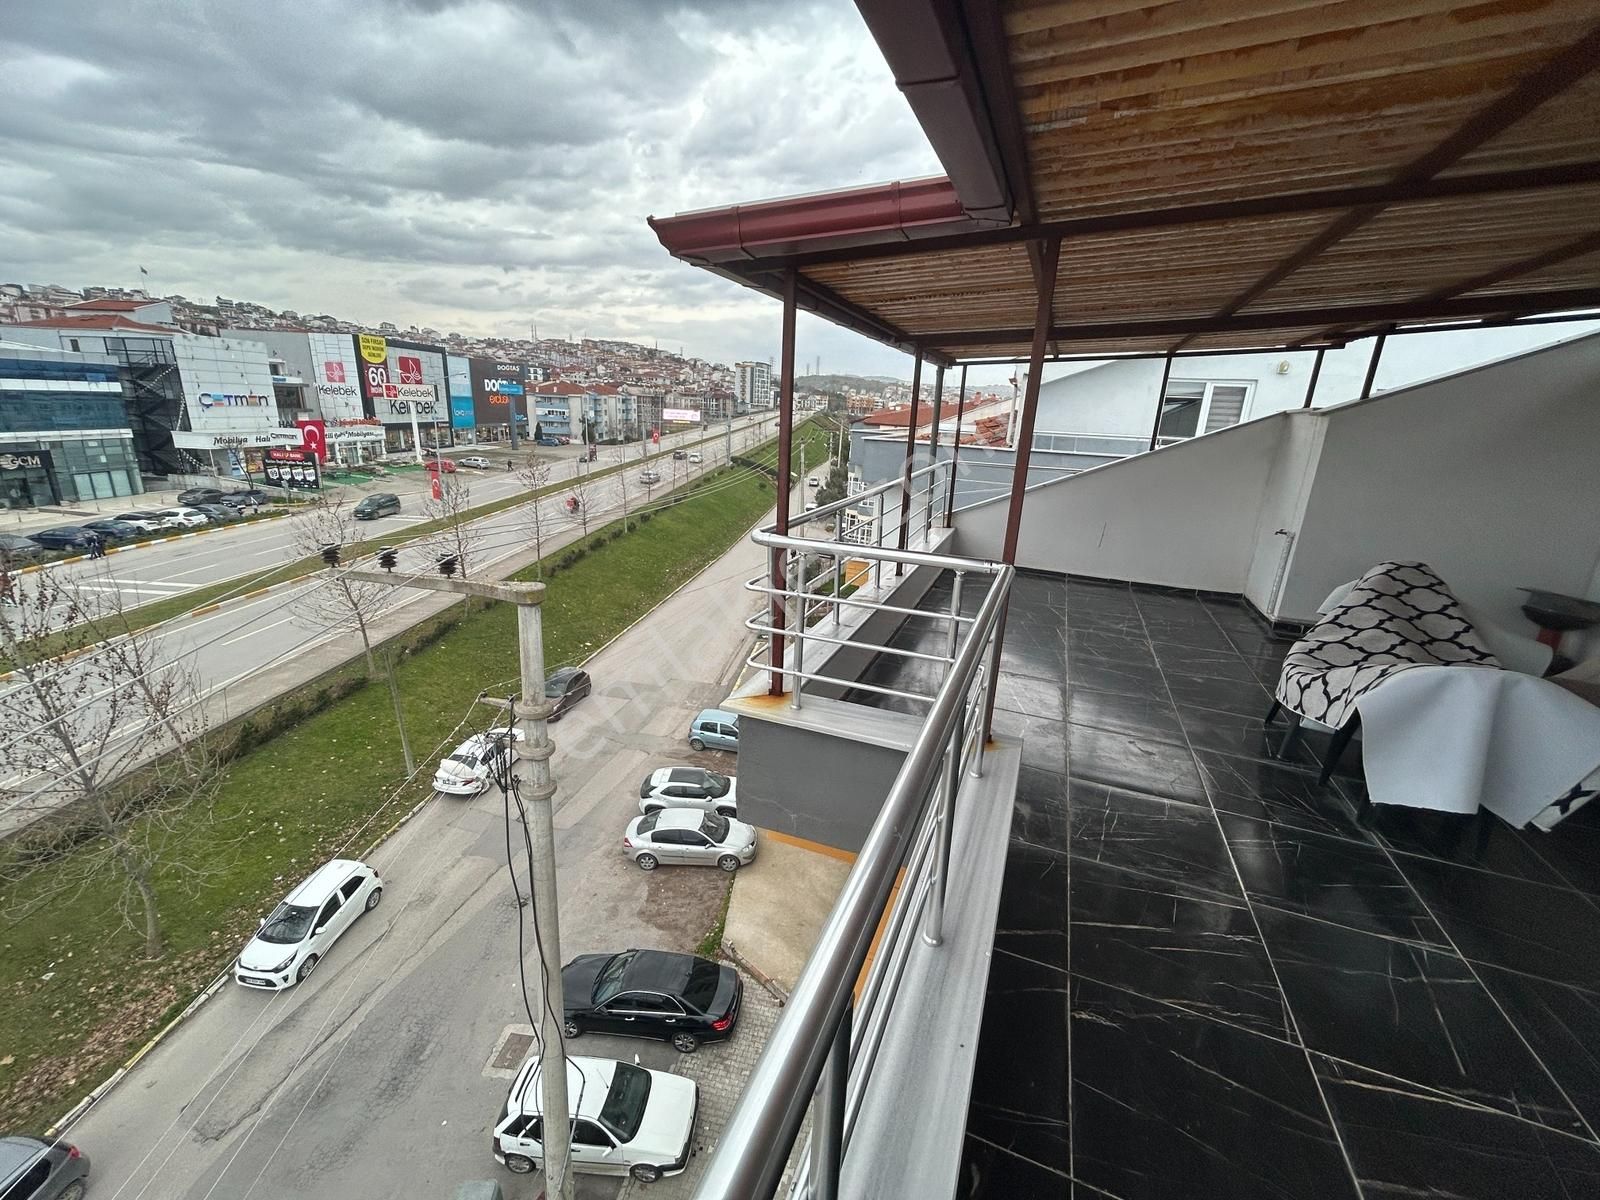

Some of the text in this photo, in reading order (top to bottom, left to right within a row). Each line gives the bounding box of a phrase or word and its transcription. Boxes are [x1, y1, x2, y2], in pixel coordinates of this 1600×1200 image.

[318, 384, 357, 396] Kelebek
[398, 387, 434, 398] Kelebek
[389, 399, 437, 415] Kelbek
[213, 436, 248, 446] Mobilya
[8, 456, 41, 467] GCM
